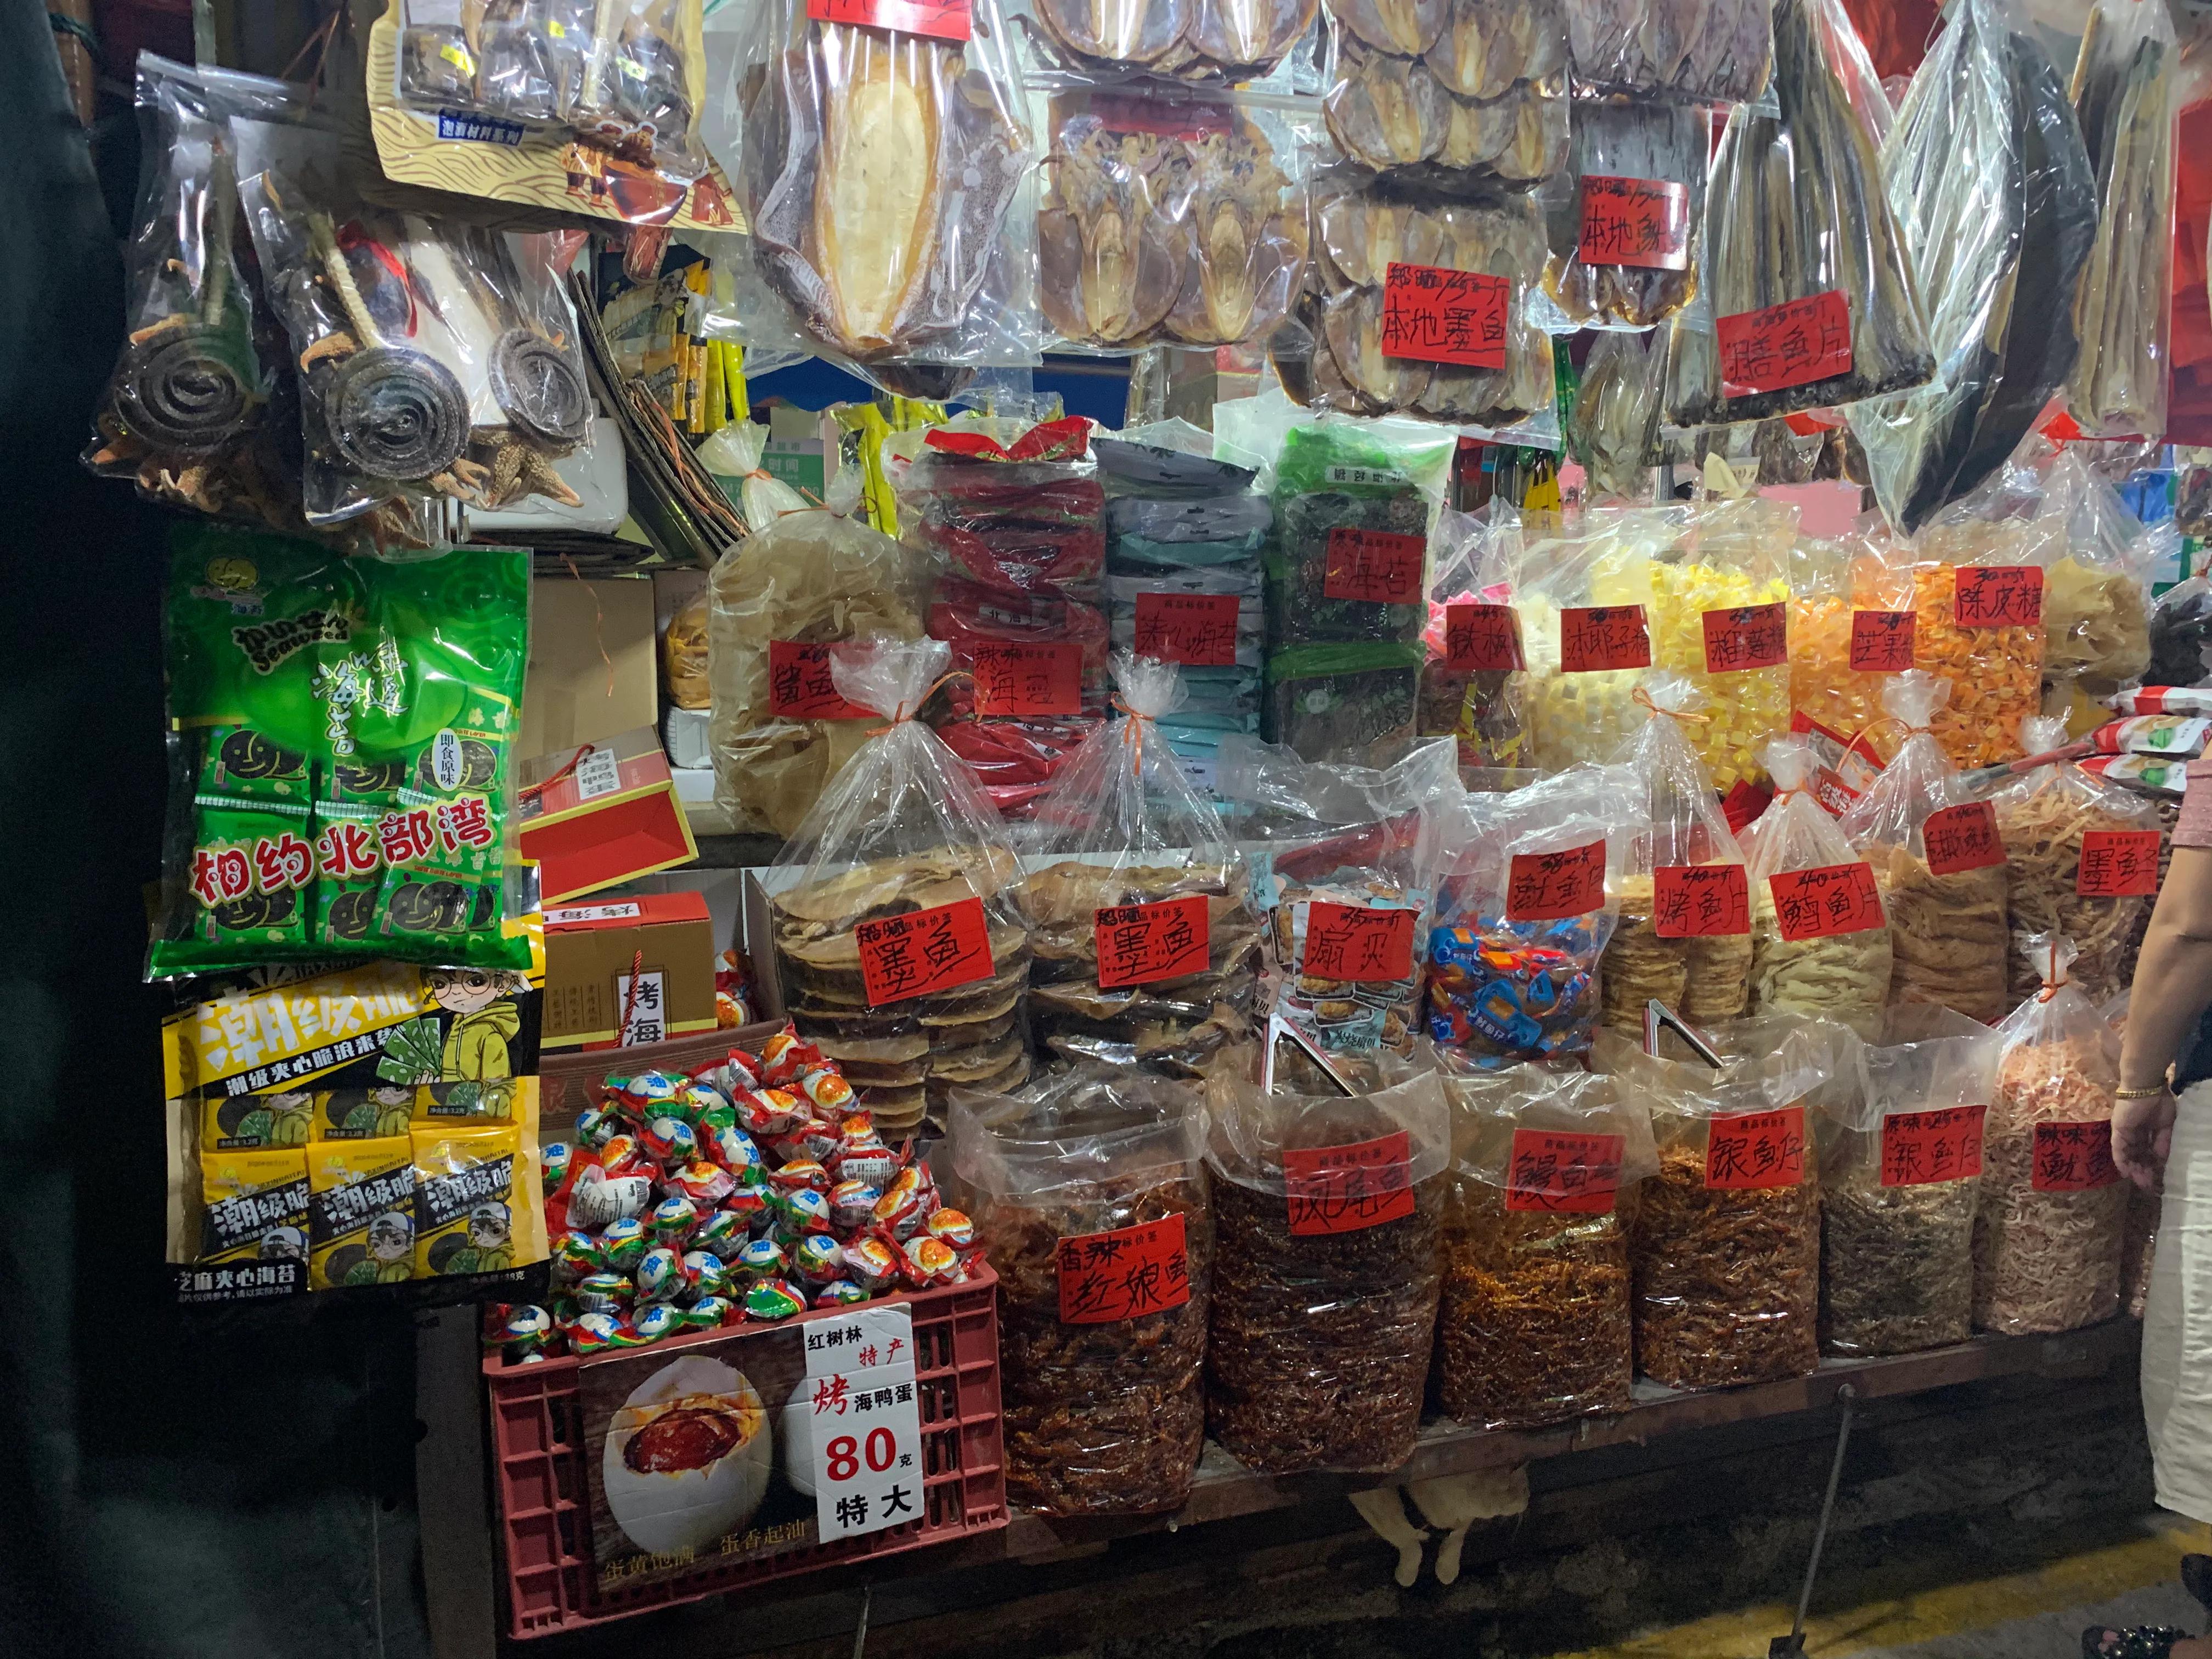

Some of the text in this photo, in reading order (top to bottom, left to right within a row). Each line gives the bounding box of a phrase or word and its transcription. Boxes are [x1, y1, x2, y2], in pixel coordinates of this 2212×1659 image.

[1382, 294, 1508, 353] 本地墨鱼
[774, 662, 848, 712] 鲨鱼
[440, 733, 456, 786] 即食原味
[193, 798, 492, 905] 相约北部湾
[877, 919, 981, 997] 墨鱼
[1113, 911, 1209, 981] 墨鱼
[1305, 923, 1388, 974] 扇贝
[1711, 1131, 1805, 1181] 银鱼仔
[179, 1263, 296, 1291] 芝麻夹心海苔
[1069, 1251, 1194, 1320] 红娘鱼
[808, 1325, 863, 1352] 红树林
[859, 1338, 905, 1367] 特产
[812, 1373, 913, 1416] 烤 海鸭蛋
[826, 1426, 913, 1482] 80 克
[836, 1484, 913, 1529] 特大
